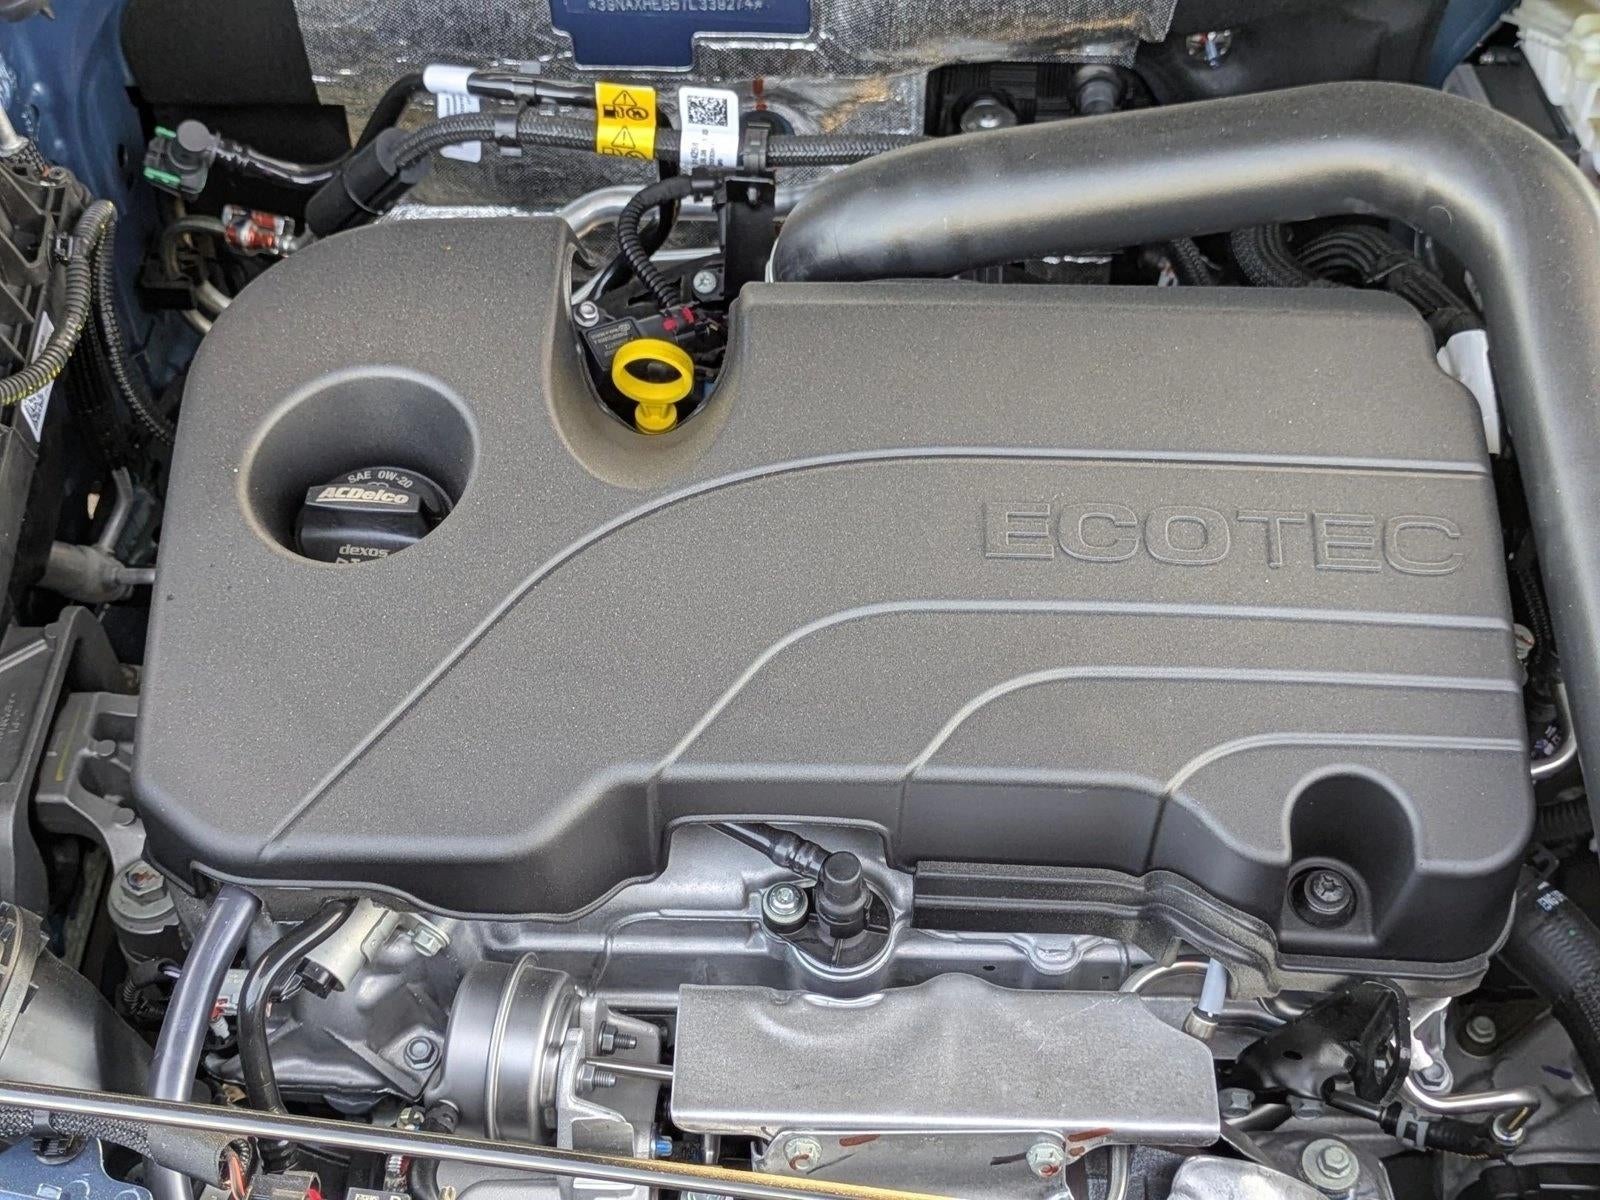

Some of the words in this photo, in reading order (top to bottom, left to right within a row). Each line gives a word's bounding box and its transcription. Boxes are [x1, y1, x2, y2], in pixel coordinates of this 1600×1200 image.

[347, 470, 372, 484] SAE
[377, 470, 414, 489] 0W-20
[318, 486, 410, 504] ACDelco
[982, 501, 1464, 577] ECOTEC
[338, 543, 389, 558] dexos
